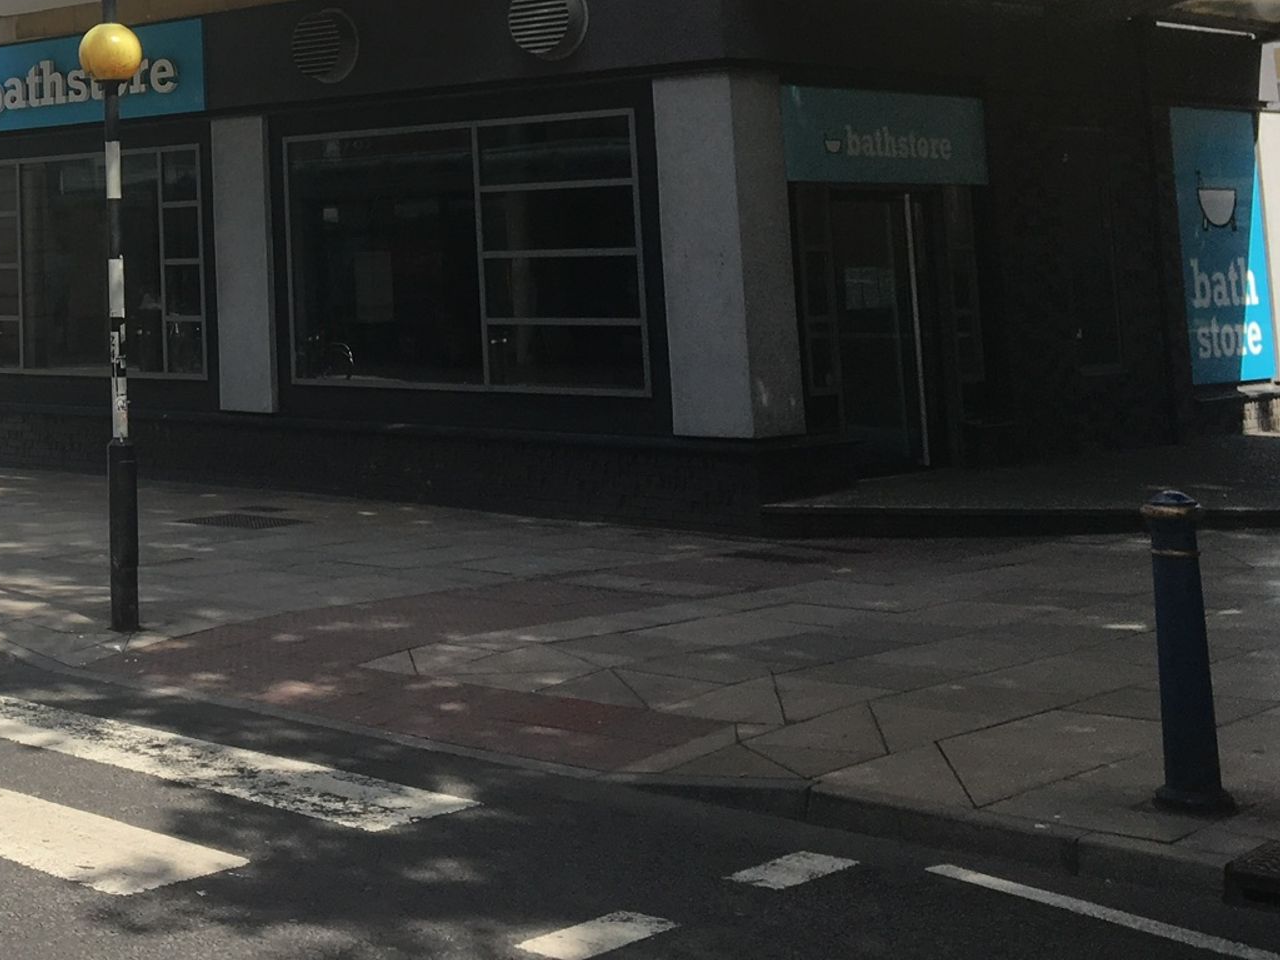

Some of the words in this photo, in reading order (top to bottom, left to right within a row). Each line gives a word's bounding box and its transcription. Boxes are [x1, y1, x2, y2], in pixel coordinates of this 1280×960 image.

[844, 123, 952, 160] bathstore
[1190, 256, 1259, 309] bath
[1197, 316, 1263, 359] store
